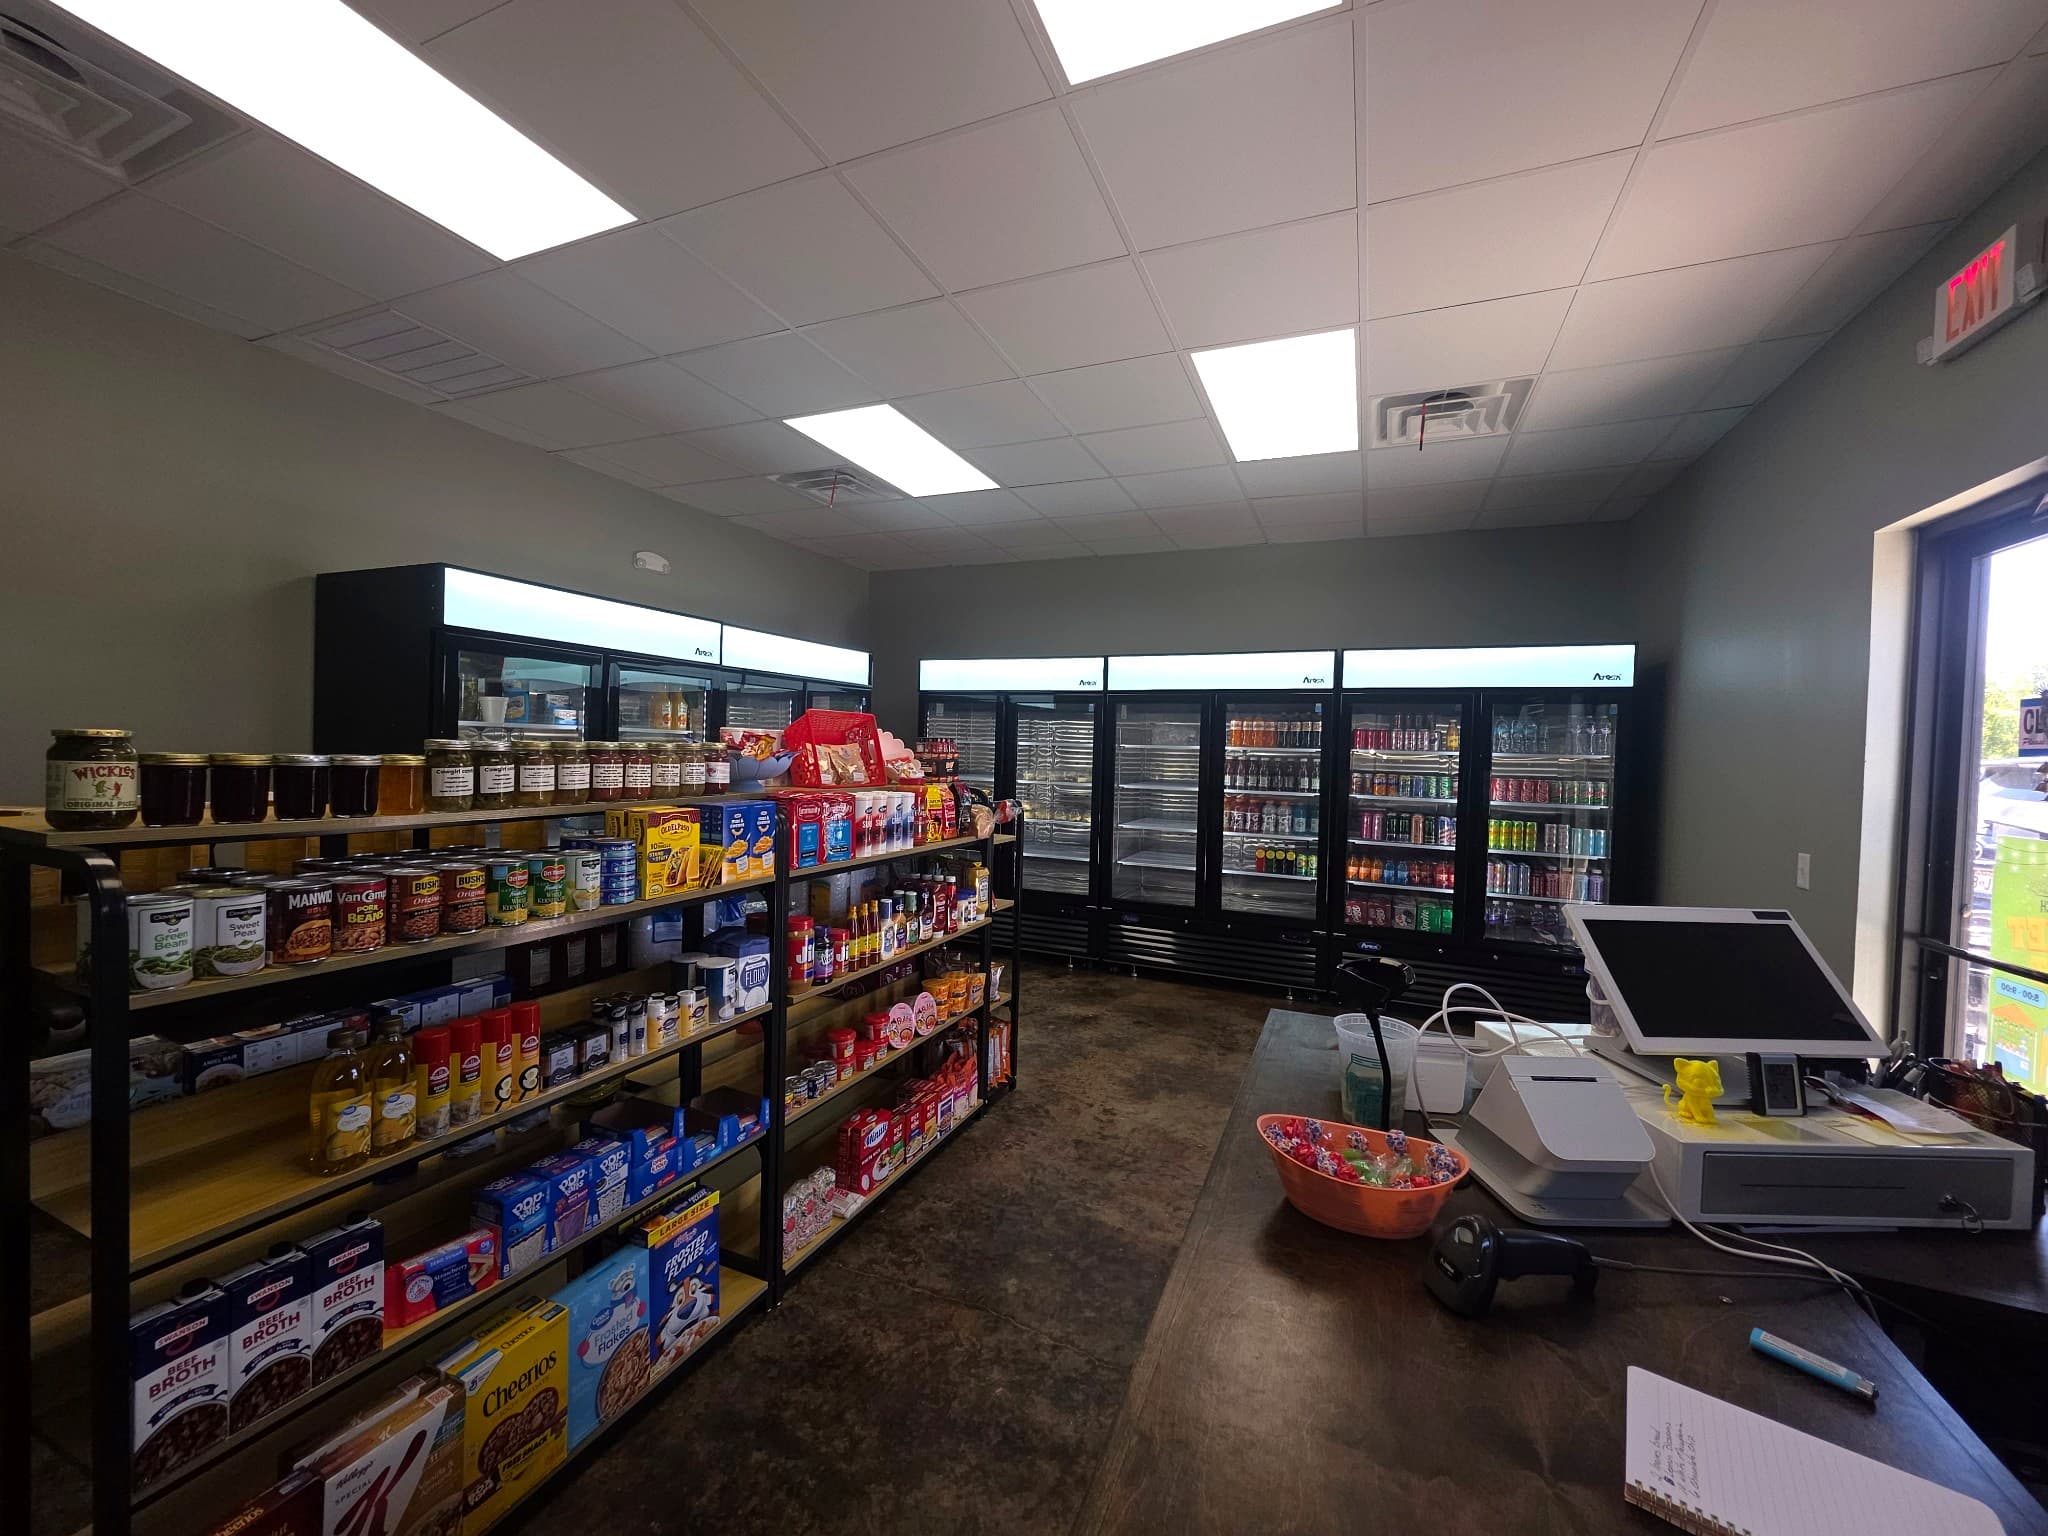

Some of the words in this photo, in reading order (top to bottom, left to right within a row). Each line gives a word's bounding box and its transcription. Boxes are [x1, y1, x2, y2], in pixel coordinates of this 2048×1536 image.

[1946, 240, 2006, 342] EXIT
[347, 909, 384, 924] BEANS
[357, 904, 379, 913] PORK
[154, 931, 189, 943] Green
[229, 920, 260, 931] Sweet
[233, 930, 257, 938] Peas
[154, 939, 189, 951] Beans
[745, 966, 767, 987] FLOUR
[659, 1216, 688, 1237] LARGE
[690, 1200, 710, 1217] SIZE
[331, 1244, 369, 1266] SWANSON
[664, 1230, 709, 1274] FROSTED
[667, 1242, 705, 1282] FLAKES
[250, 1278, 292, 1304] SWANSON
[323, 1275, 375, 1308] BROTH
[336, 1273, 361, 1291] BEEF
[158, 1319, 207, 1345] SWANSON
[242, 1311, 301, 1350] BROTH
[258, 1310, 286, 1330] BEEF
[593, 1308, 633, 1348] Frosted
[149, 1354, 216, 1399] BROTH
[167, 1354, 199, 1376] BEEF
[483, 1350, 557, 1418] Cheerios
[336, 1479, 372, 1505] SPECIAL
[212, 1507, 265, 1536] heerios
